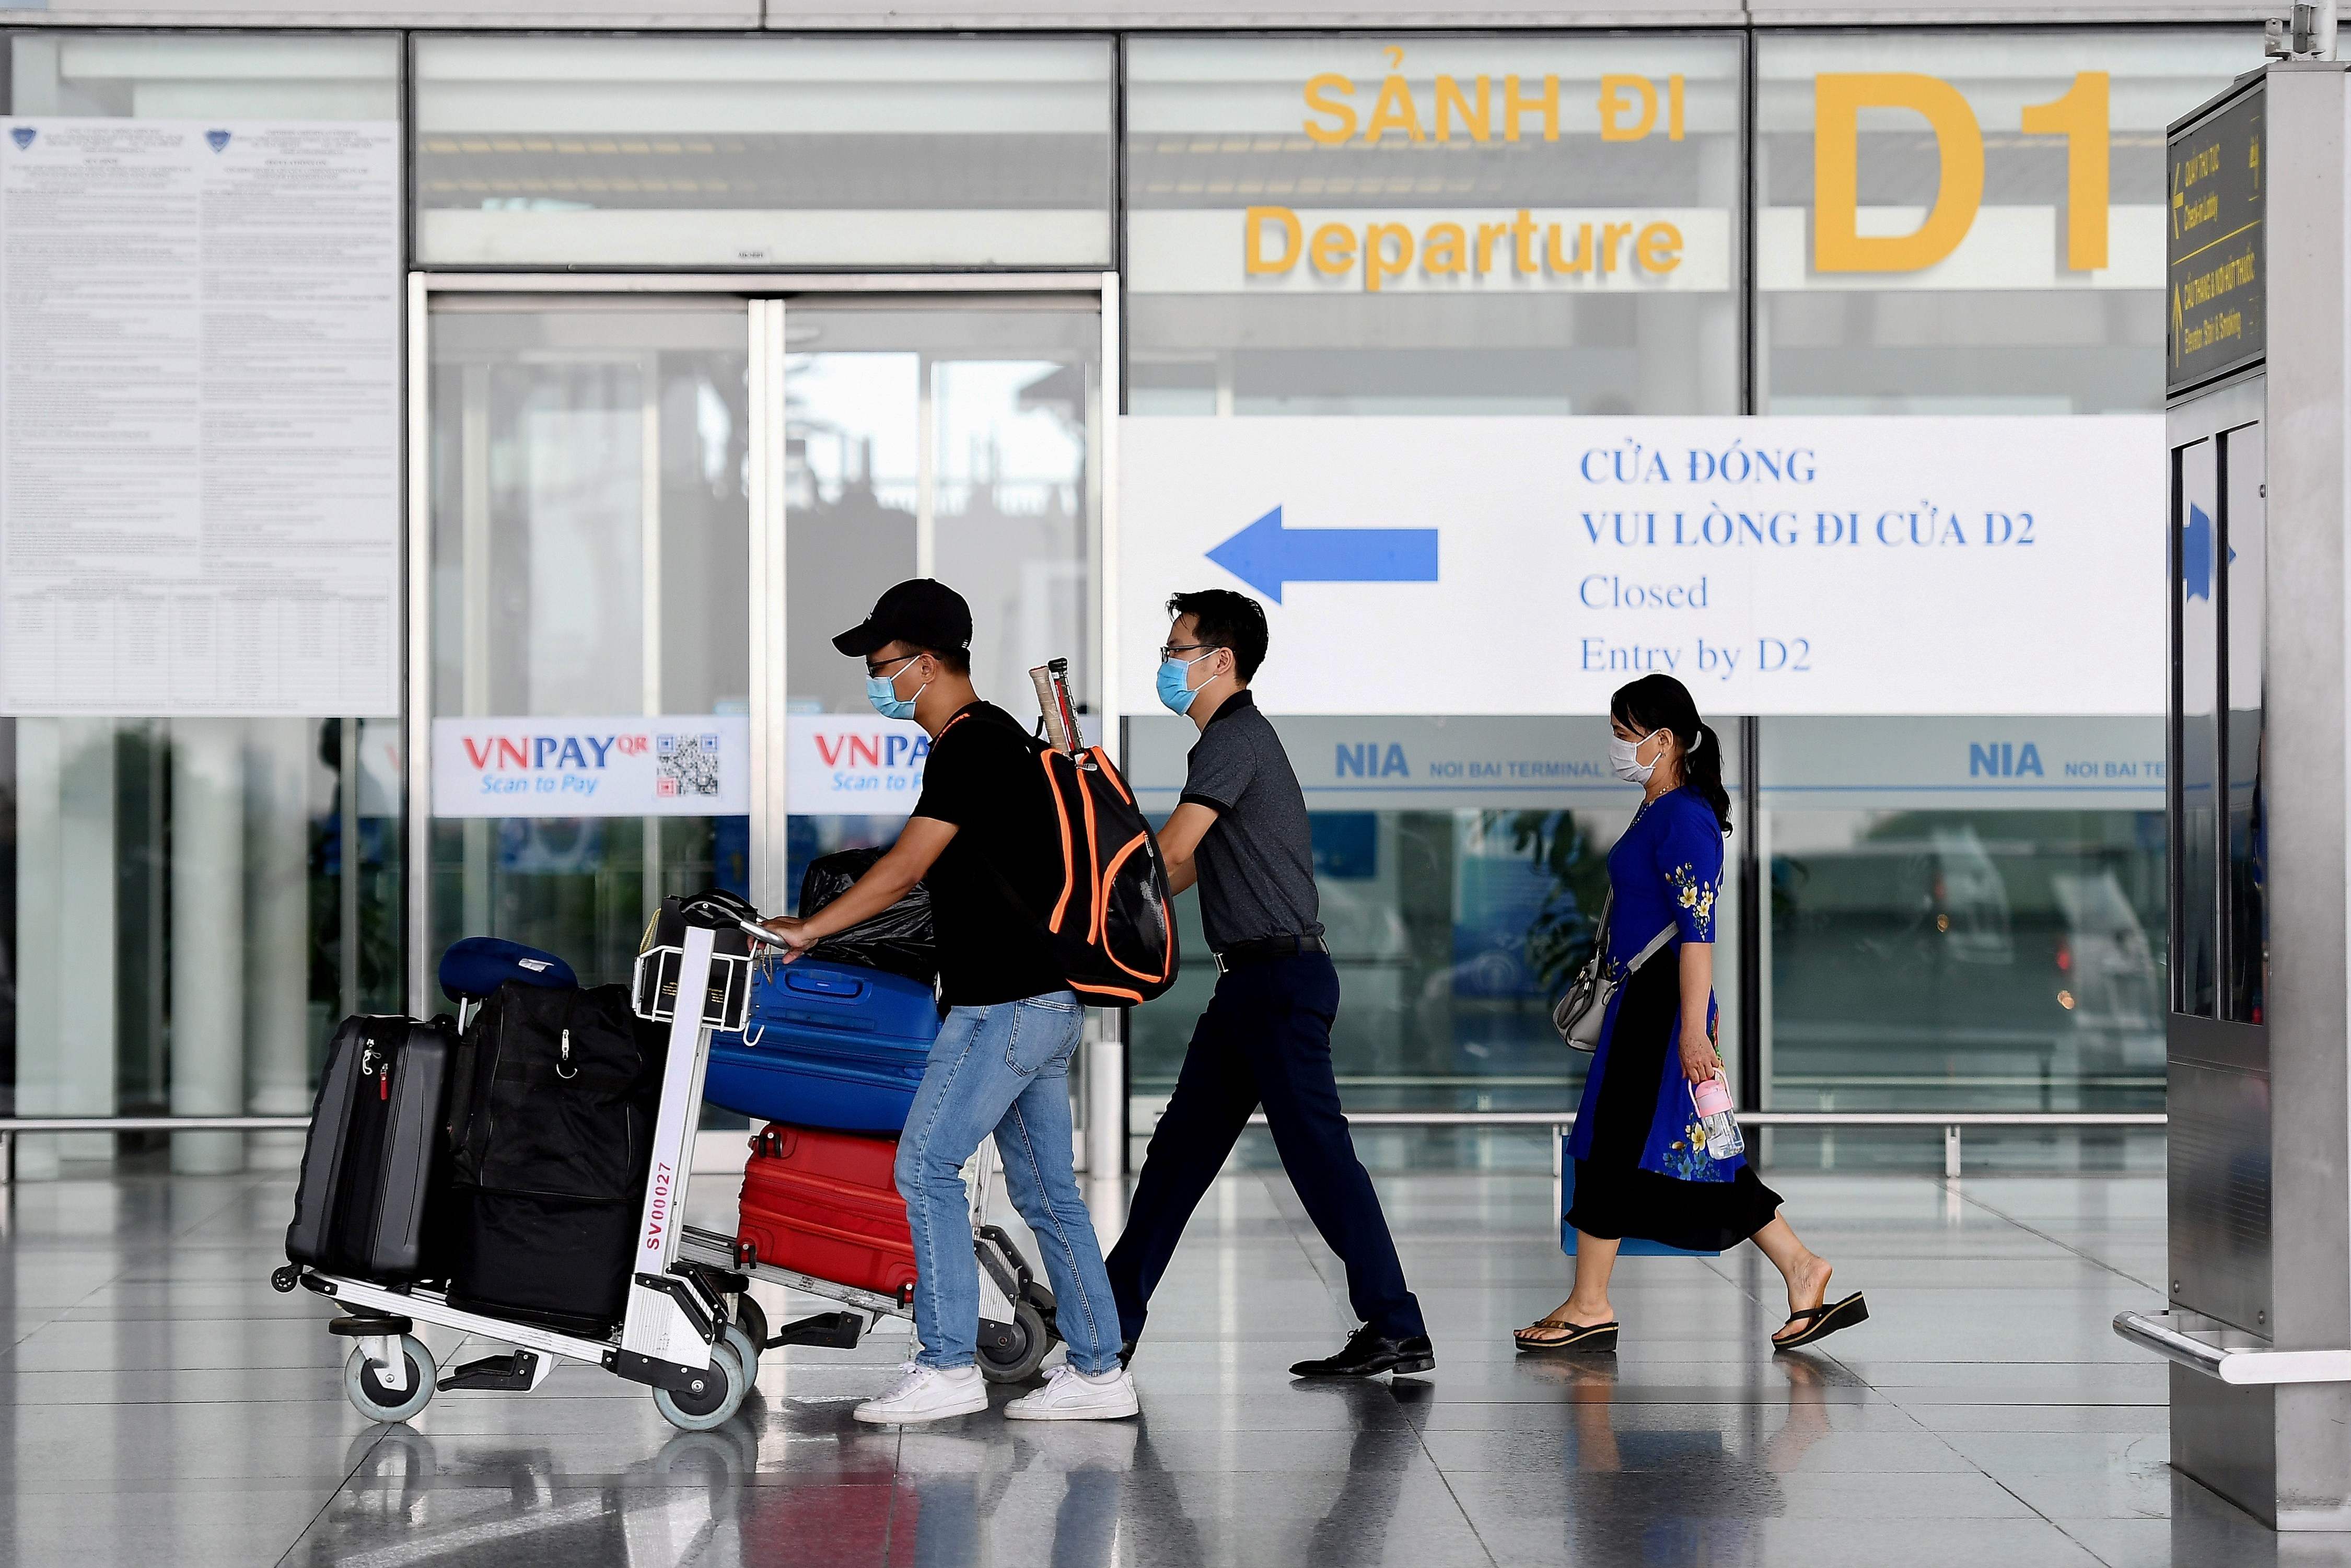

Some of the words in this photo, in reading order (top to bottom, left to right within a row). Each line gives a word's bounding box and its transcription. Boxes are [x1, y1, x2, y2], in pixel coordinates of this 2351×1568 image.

[1302, 45, 1560, 144] SẢNH
[1597, 74, 1684, 142] ĐI
[1814, 71, 2110, 272] D1
[1246, 206, 1684, 292] Departure
[1579, 437, 1672, 484] CỬA
[1687, 438, 1817, 484] ĐÓNG
[1580, 510, 1657, 547] VUI
[1673, 501, 1799, 547] LÒNG
[1814, 510, 1860, 545] ĐI
[1875, 500, 1968, 547] CỬA
[1983, 510, 2035, 545] D2
[1579, 574, 1709, 610] Closed
[1580, 637, 1681, 673] Entry
[1696, 637, 1741, 681] by
[1757, 637, 1811, 672] D2
[462, 735, 616, 771] VNPAY
[813, 733, 930, 768] VNPA
[1334, 741, 1410, 779] NIA
[1968, 740, 2045, 778] NIA
[2065, 761, 2098, 778] NOI
[2104, 761, 2136, 778] BAI
[481, 774, 529, 795] Scan
[535, 775, 557, 794] to
[561, 774, 599, 796] Pay
[832, 770, 880, 792] Scan
[886, 774, 907, 791] to
[1430, 762, 1463, 778] NOI
[1469, 762, 1502, 778] BAI
[1508, 762, 1603, 778] TERMINAL
[646, 1162, 671, 1250] SV00027
